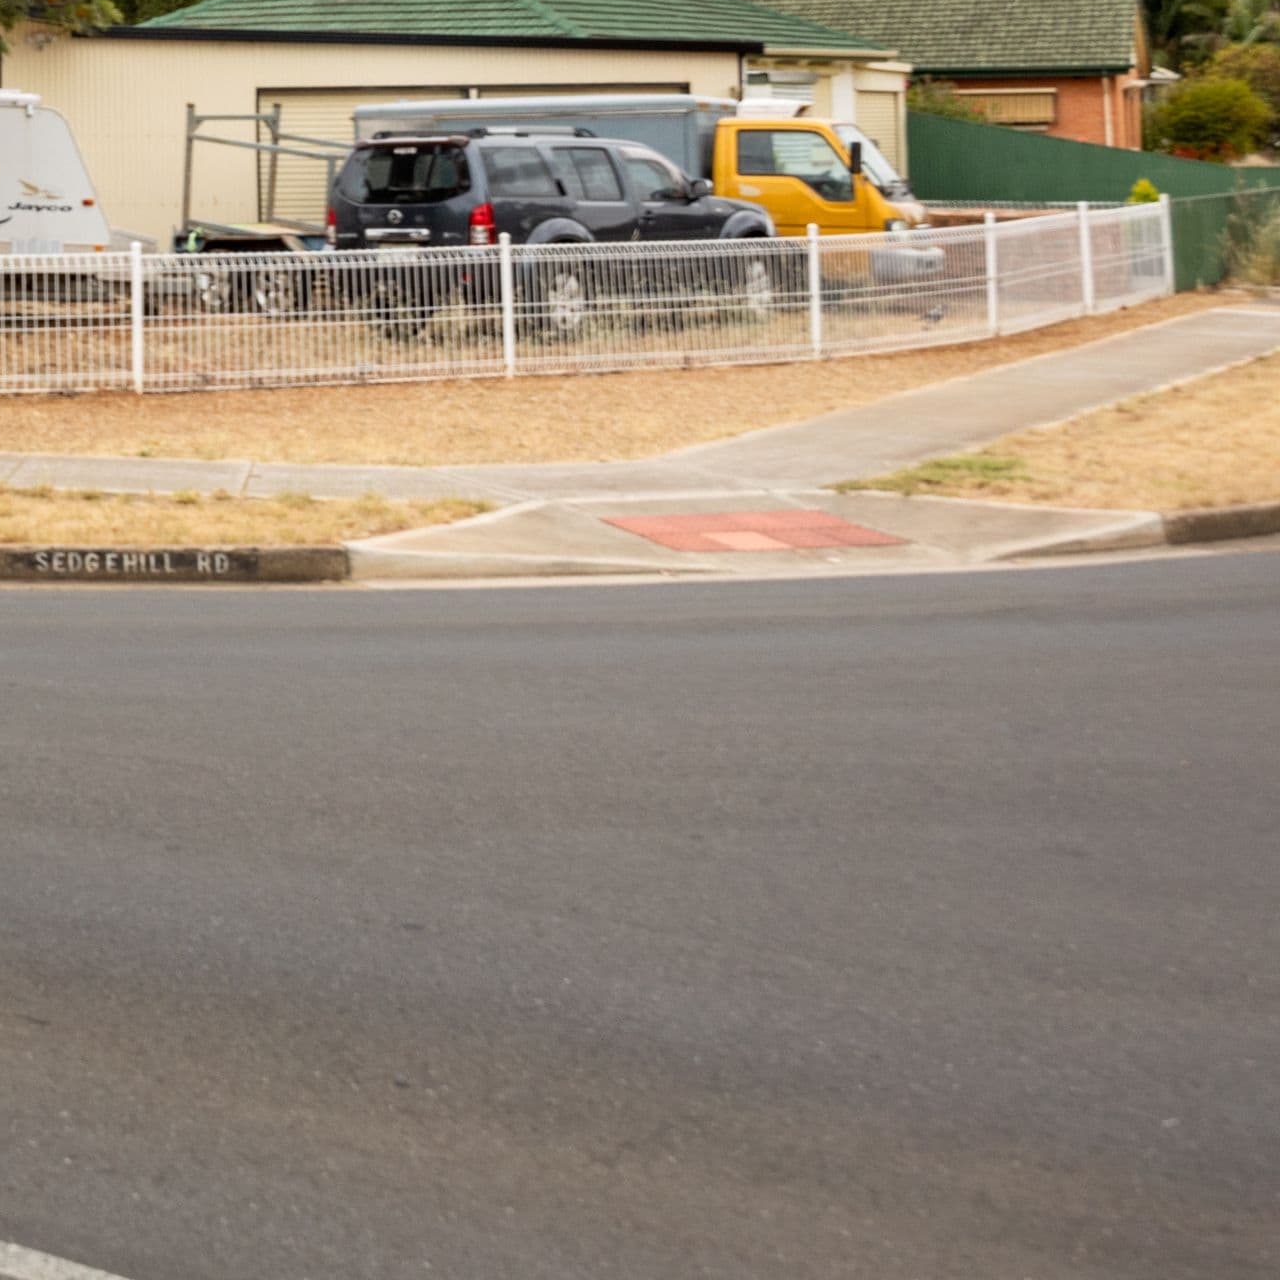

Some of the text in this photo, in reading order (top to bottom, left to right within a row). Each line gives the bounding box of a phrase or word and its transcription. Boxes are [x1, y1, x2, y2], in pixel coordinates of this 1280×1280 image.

[7, 202, 73, 212] Jayco
[35, 552, 230, 573] SEDGEHILL RD
